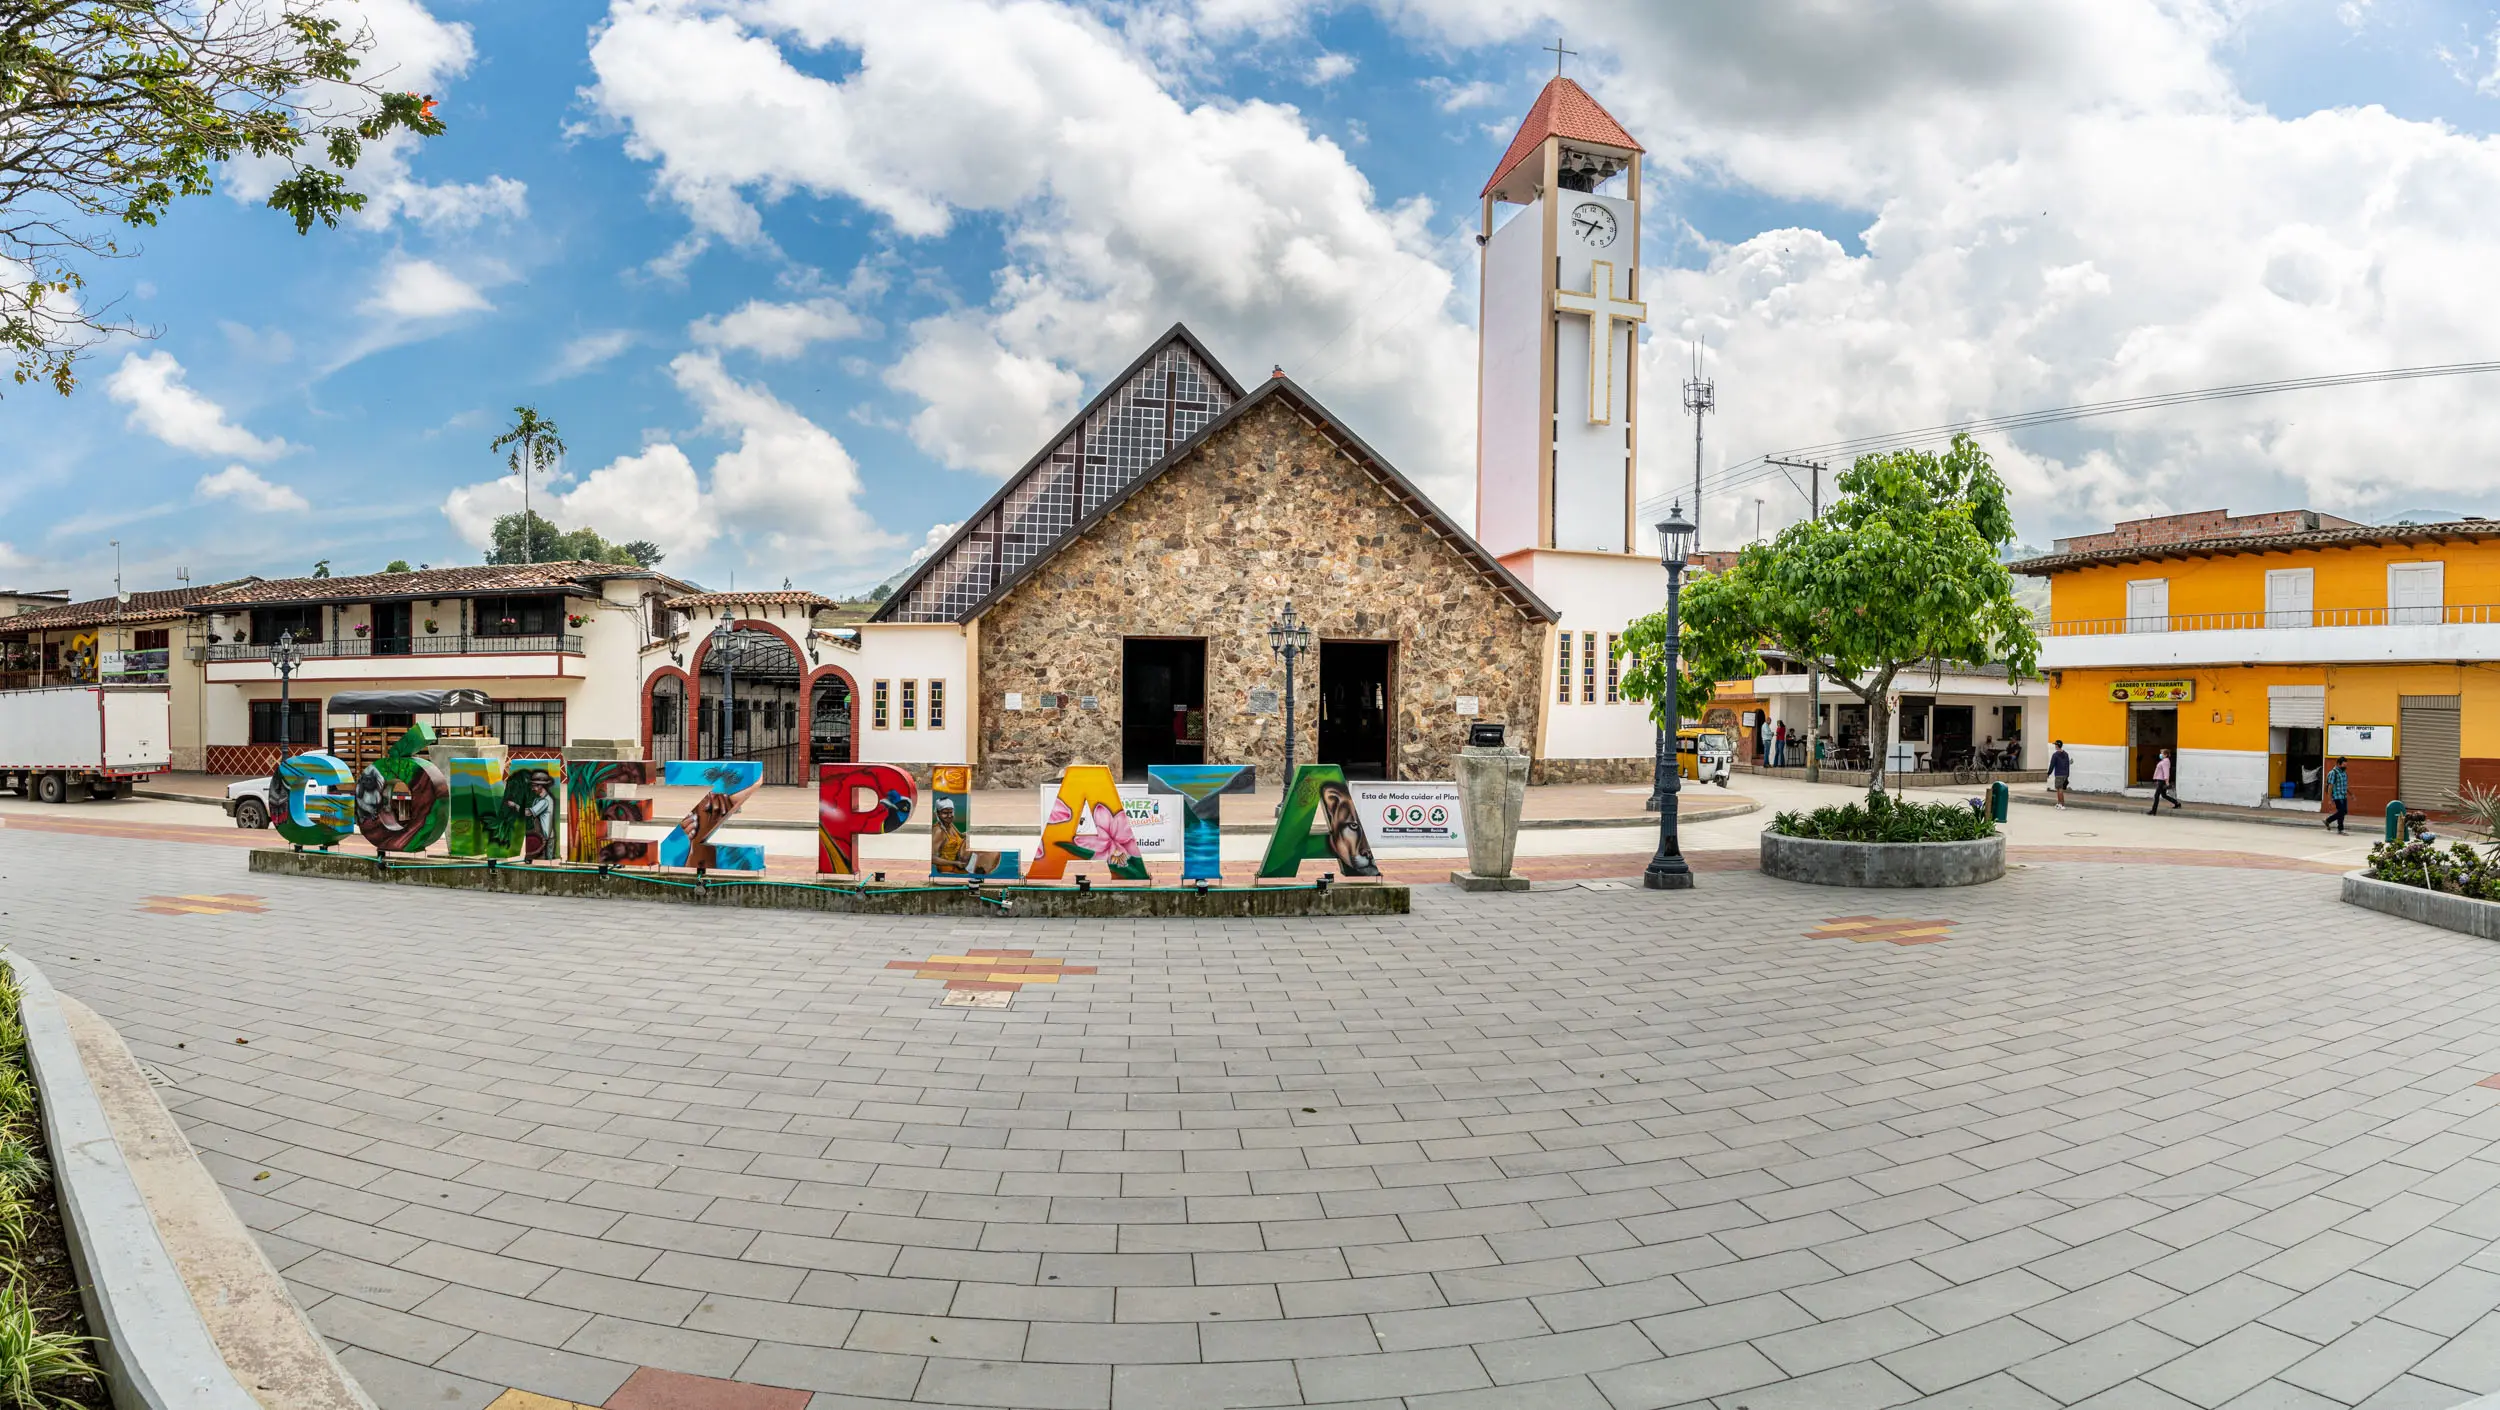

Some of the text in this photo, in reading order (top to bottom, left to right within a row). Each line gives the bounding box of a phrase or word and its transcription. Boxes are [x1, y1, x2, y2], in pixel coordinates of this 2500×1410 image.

[268, 721, 1382, 881] GÓMEZ PLATA
[1122, 800, 1151, 809] MEZ
